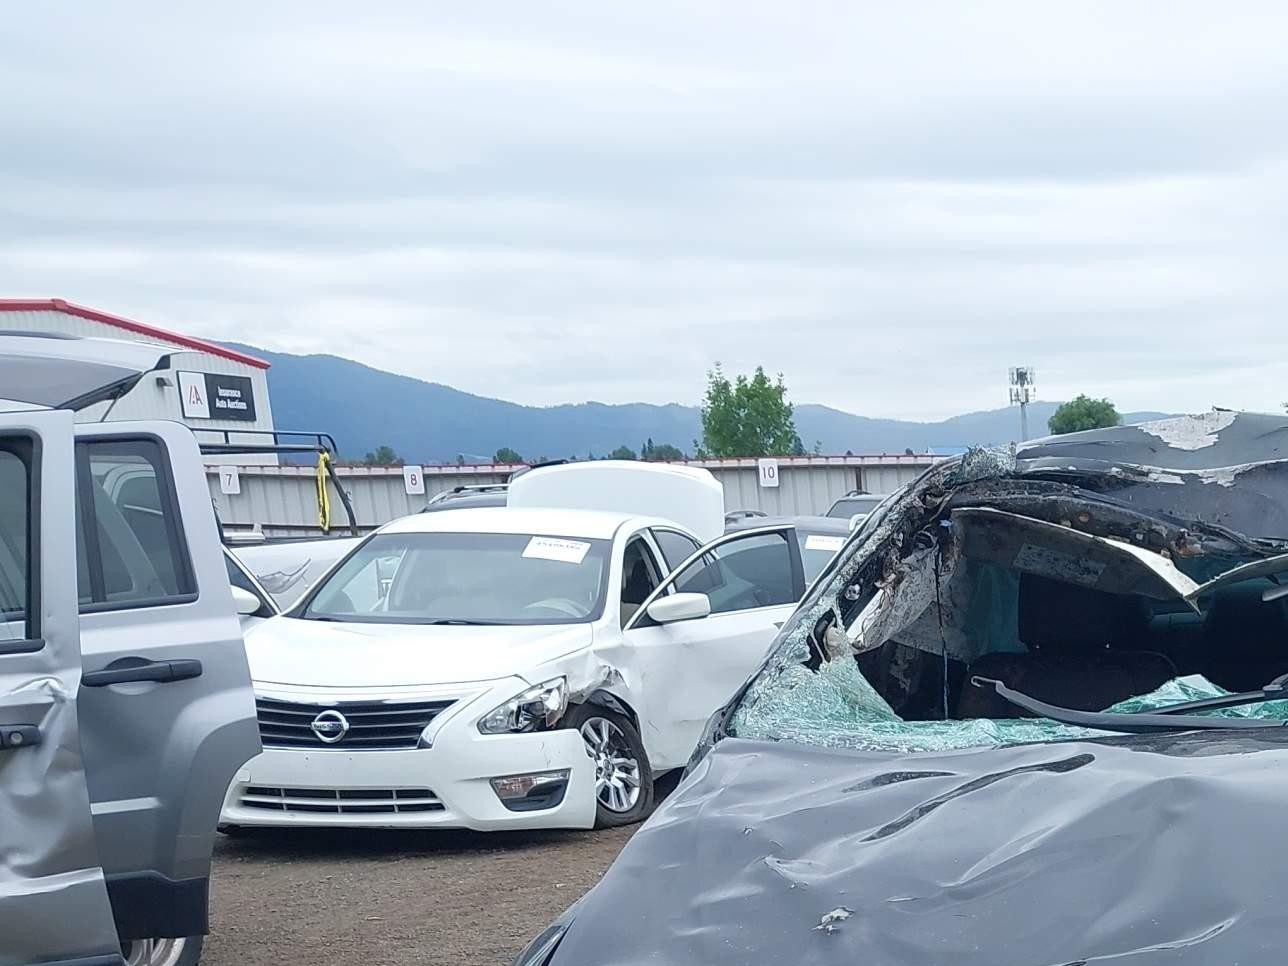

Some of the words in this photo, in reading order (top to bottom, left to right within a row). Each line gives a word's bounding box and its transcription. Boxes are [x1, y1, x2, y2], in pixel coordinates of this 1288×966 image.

[216, 398, 227, 408] Auto
[763, 466, 774, 479] 10
[225, 474, 232, 486] 7
[411, 474, 417, 485] 8
